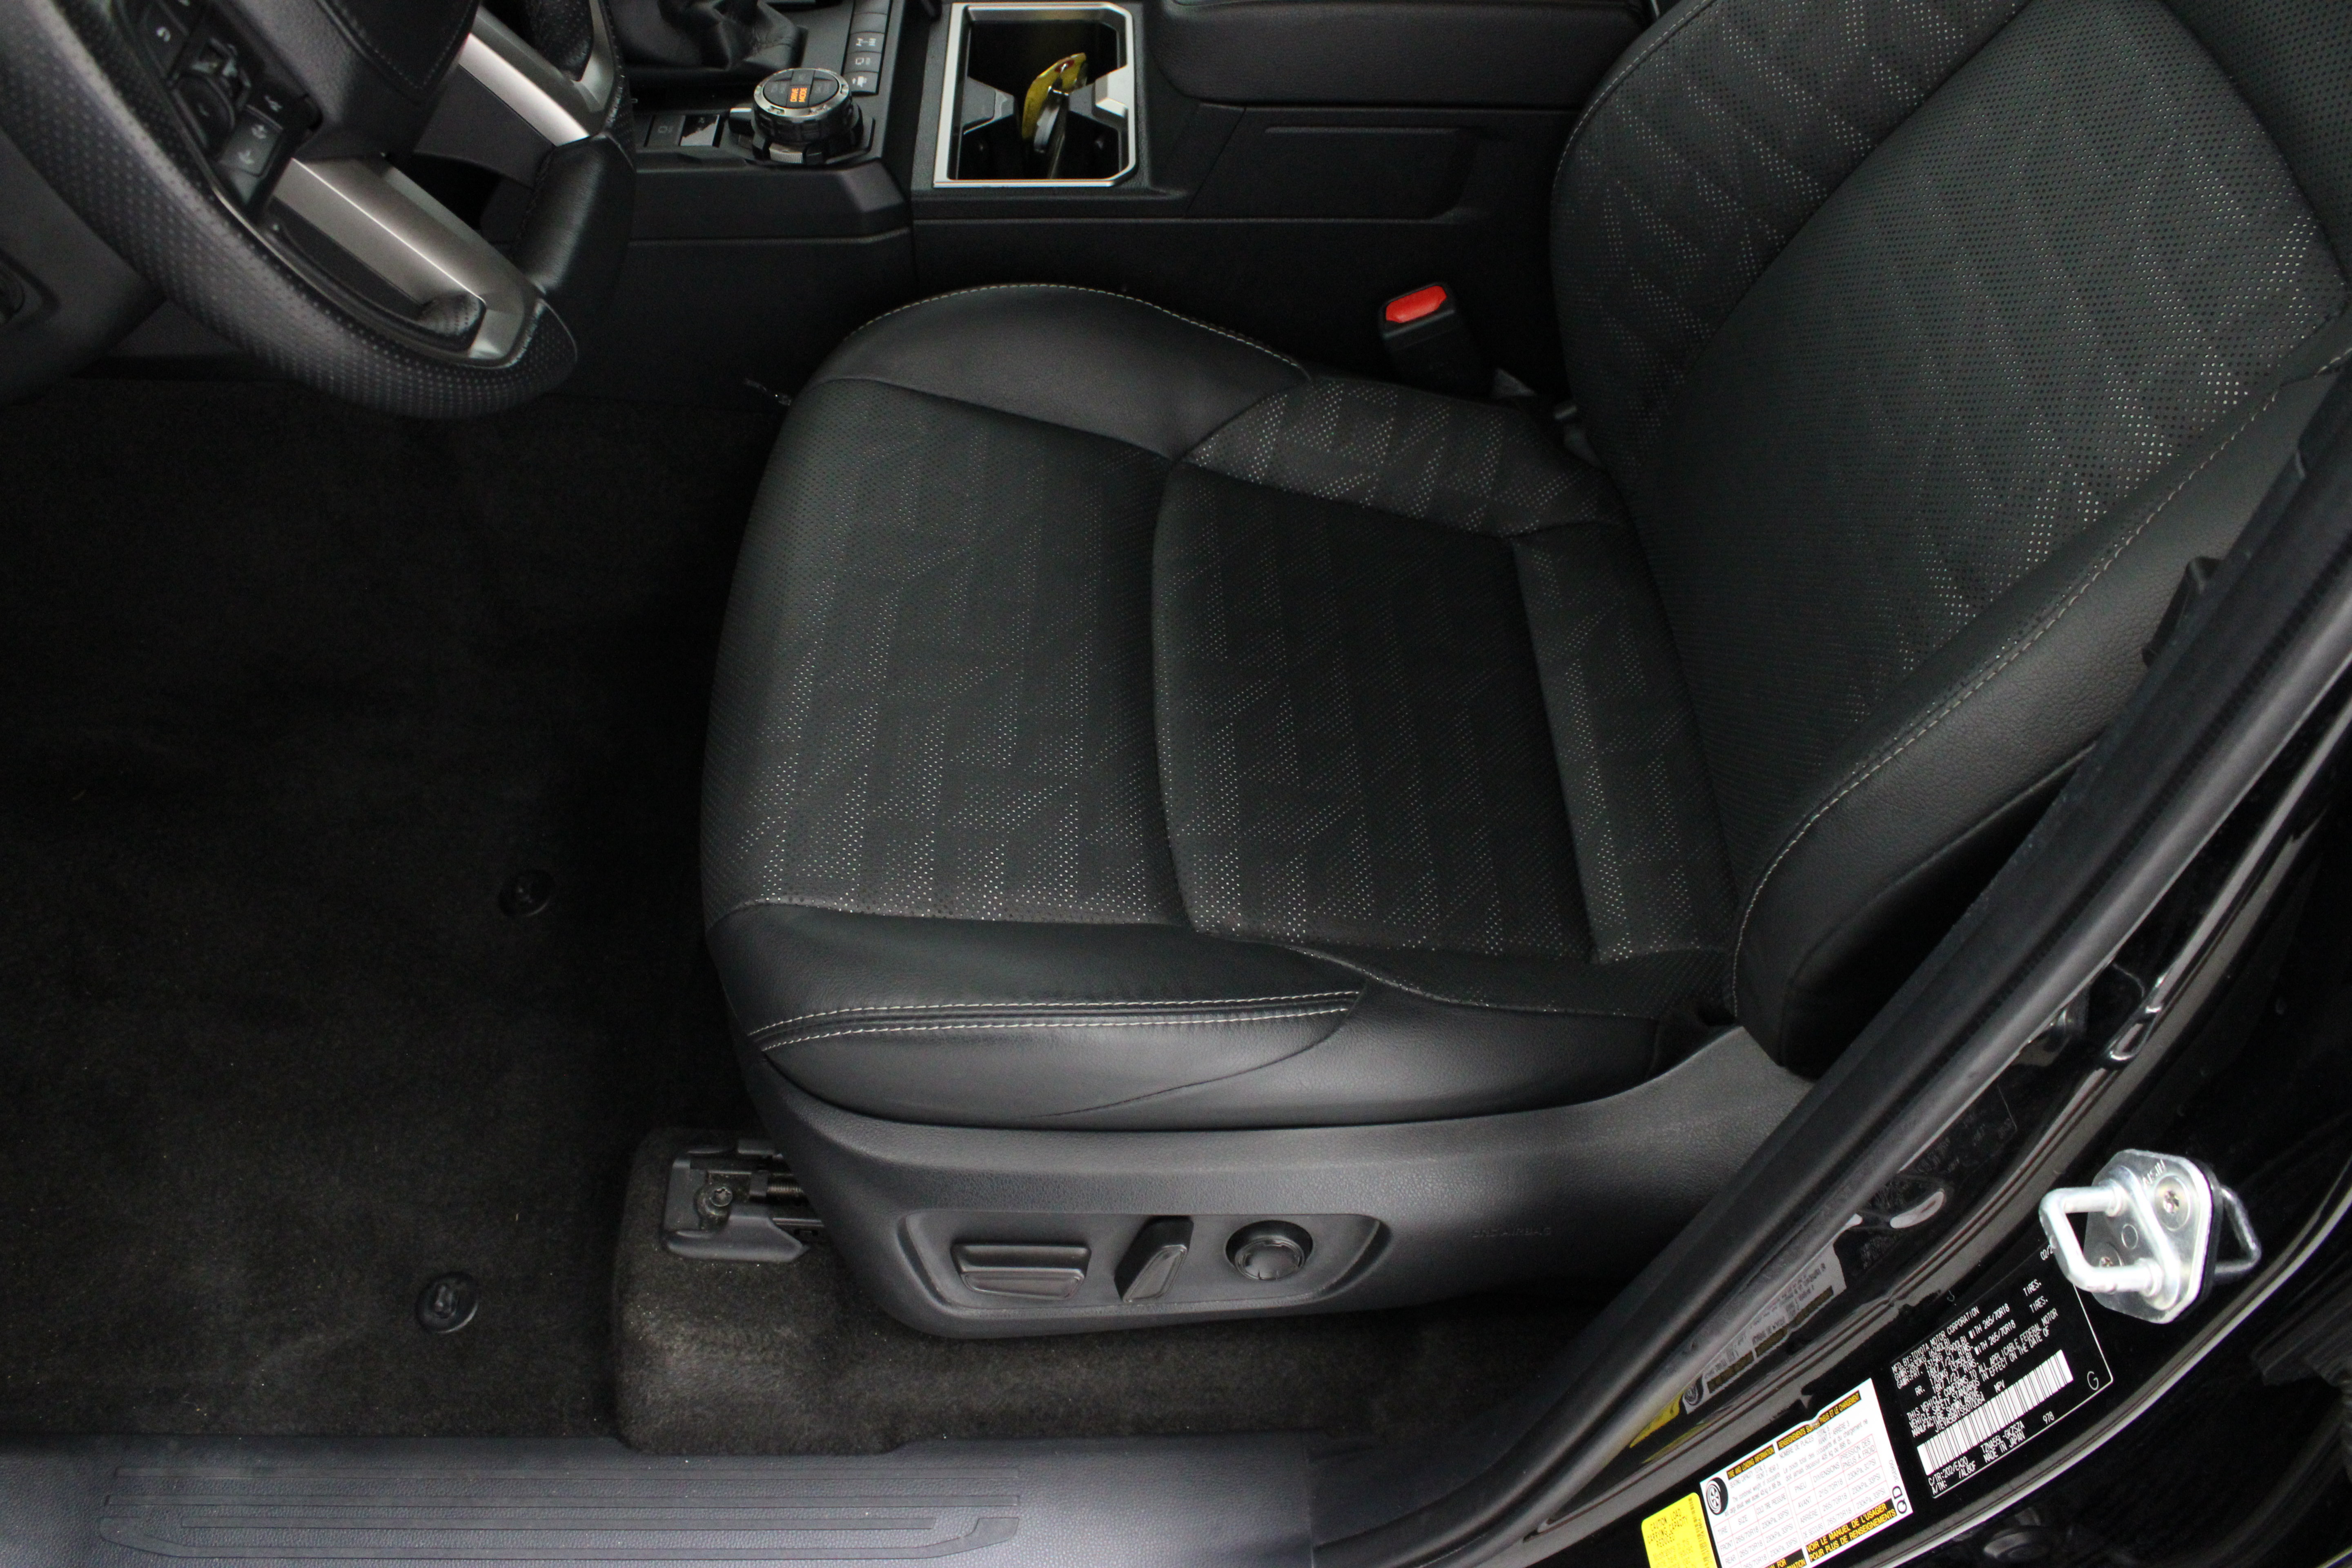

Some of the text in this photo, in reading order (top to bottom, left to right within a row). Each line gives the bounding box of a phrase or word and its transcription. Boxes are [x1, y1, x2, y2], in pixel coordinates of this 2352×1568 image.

[790, 87, 799, 102] DRIVE
[799, 87, 808, 102] MODE
[2040, 1244, 2053, 1261] 02/2
[1924, 1353, 1943, 1370] 1315KG
[1944, 1336, 1968, 1355] (2900LB)
[1969, 1324, 1982, 1339] WITH
[1982, 1303, 2009, 1329] 265/70R18
[2023, 1279, 2041, 1296] TIRES.
[1930, 1331, 1946, 1347] MOTOR
[1947, 1307, 1979, 1334] CORPORATION
[1915, 1296, 2048, 1396] RR. 1700KG (3755LB) WITH 265/70R18 TIRES.
[1929, 1338, 1951, 1357] (6240LB)
[1907, 1308, 2058, 1420] THIS VEHICLE CONFORMS TO ALL APPLICABLE FEDERAL MOTOR
[1927, 1343, 1973, 1377] 18X7 1/2J RIMS.
[1909, 1325, 2049, 1431] VEHICLE SAFETY STANDARDS IN EFFECT ON THE DATE OF
[1932, 1359, 1978, 1394] 18X7 1/2J RIMS.
[1994, 1380, 2005, 1393] MPV
[2087, 1372, 2098, 1390] G
[1778, 1428, 1806, 1450] RENSEIGNEMENTS
[1829, 1409, 1833, 1417] ET
[1839, 1393, 1860, 1411] CHARGEMENT
[1911, 1410, 1945, 1437] MANUFACTURE
[1946, 1399, 1963, 1416] SHOWN
[1779, 1446, 1794, 1459] NOMBRE
[1800, 1435, 1814, 1447] PLACES
[1840, 1438, 1871, 1461] PRESSION DES
[1932, 1412, 2054, 1494] A/TM: /AL80F MADE IN JAPAN 978
[1842, 1456, 1857, 1470] PNEUS
[1862, 1445, 1875, 1458] FROID
[1813, 1462, 1840, 1483] DIMENSIONS
[1868, 1473, 1881, 1485] 33PSI
[1929, 1456, 1968, 1487] C/TR:202/EA20
[1795, 1482, 1806, 1492] PNEU
[1873, 1488, 1886, 1499] 33PSI
[1798, 1496, 1811, 1508] AVANT
[1823, 1493, 1847, 1512] 265/70R18
[1891, 1485, 1908, 1515] QD
[1650, 1508, 1681, 1531] CAUTION LOAD
[1738, 1515, 1748, 1525] SIZE
[1827, 1507, 1852, 1526] 265/70R18
[1648, 1516, 1687, 1544] CARRYING CAPACITY
[1717, 1526, 1728, 1535] TIRE
[1735, 1526, 1759, 1544] 265/70R18
[1806, 1503, 1886, 1552] VOIR LE MANUEL DE L'USAGER
[1809, 1507, 1897, 1562] POUR PLUS DE RENSEIGNEMENTS
[1656, 1532, 1674, 1547] REDUCED
[1720, 1539, 1733, 1551] FRONT
[1739, 1540, 1763, 1558] 265/70R18
[1725, 1555, 1736, 1564] REAR
[1777, 1557, 1786, 1568] FOR
